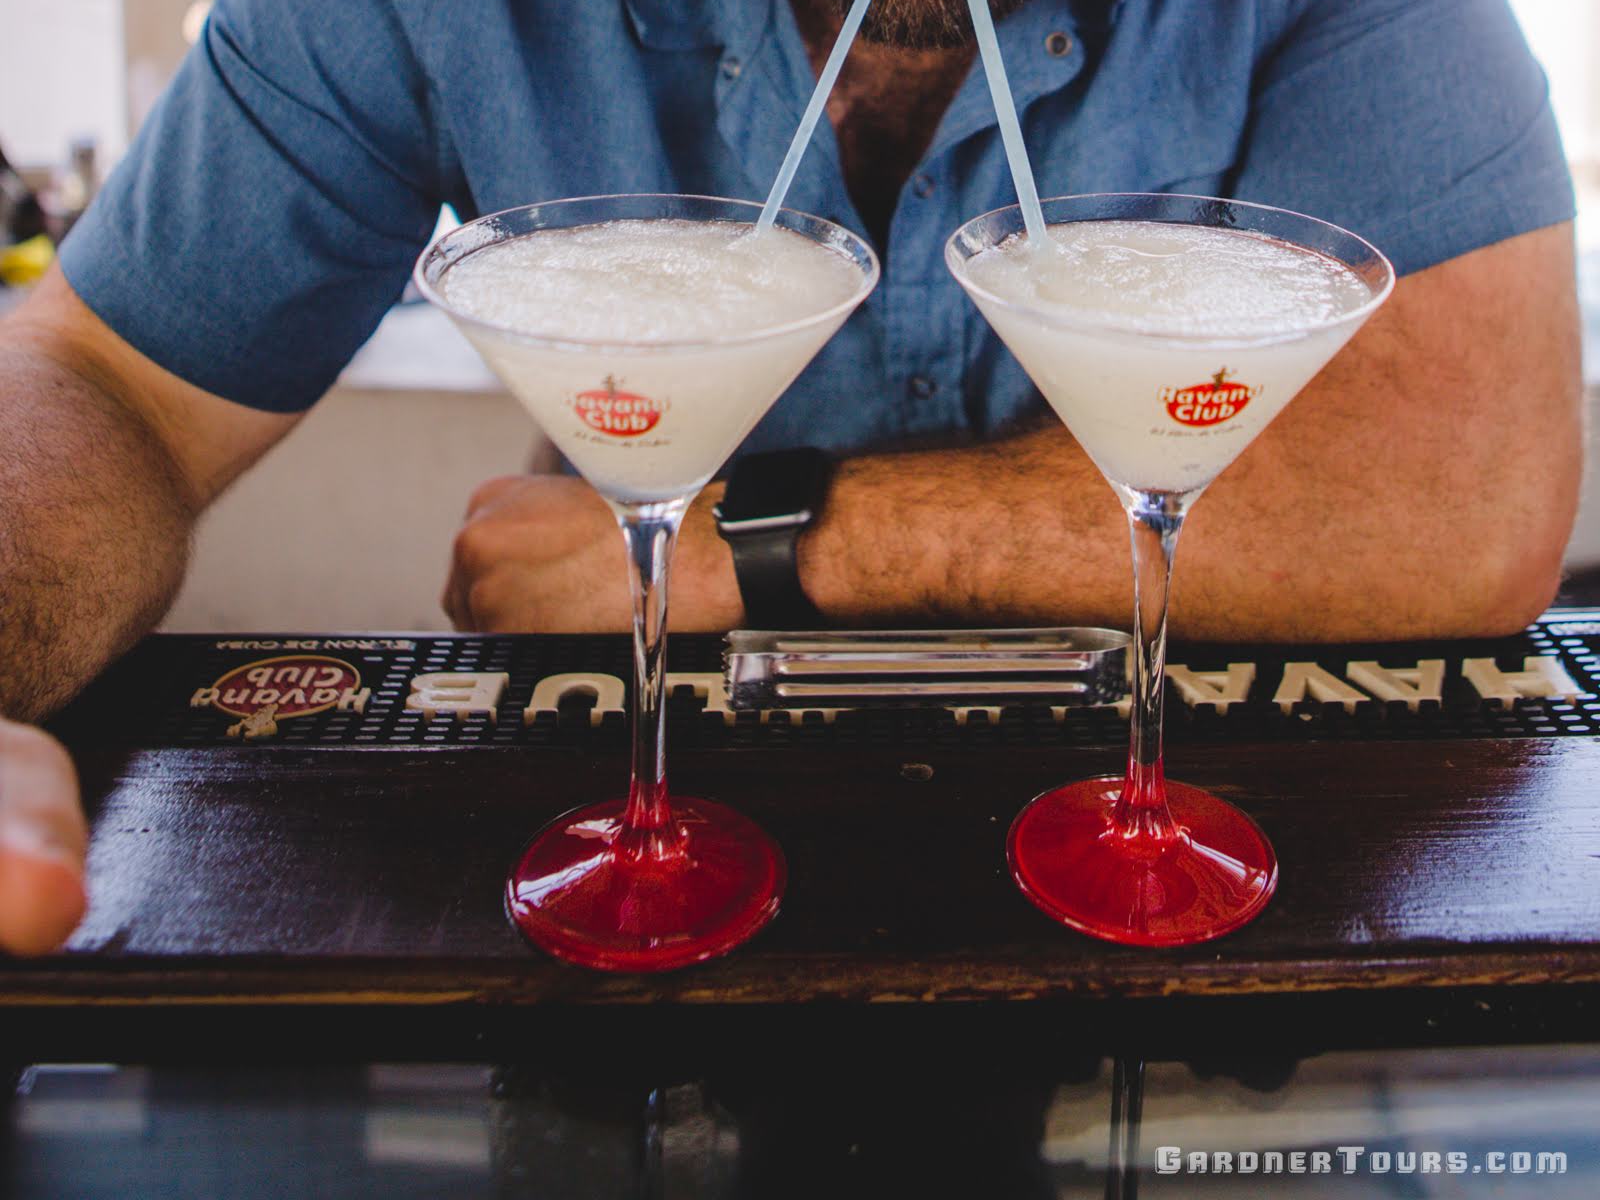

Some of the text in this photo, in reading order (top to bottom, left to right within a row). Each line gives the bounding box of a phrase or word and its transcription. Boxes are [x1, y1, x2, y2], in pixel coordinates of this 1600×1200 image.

[1157, 385, 1264, 404] Havana
[586, 411, 649, 431] Club
[1175, 403, 1235, 421] Club
[215, 640, 280, 650] CUBA
[282, 640, 320, 650] DE
[246, 666, 344, 688] Club
[190, 687, 372, 715] Havana
